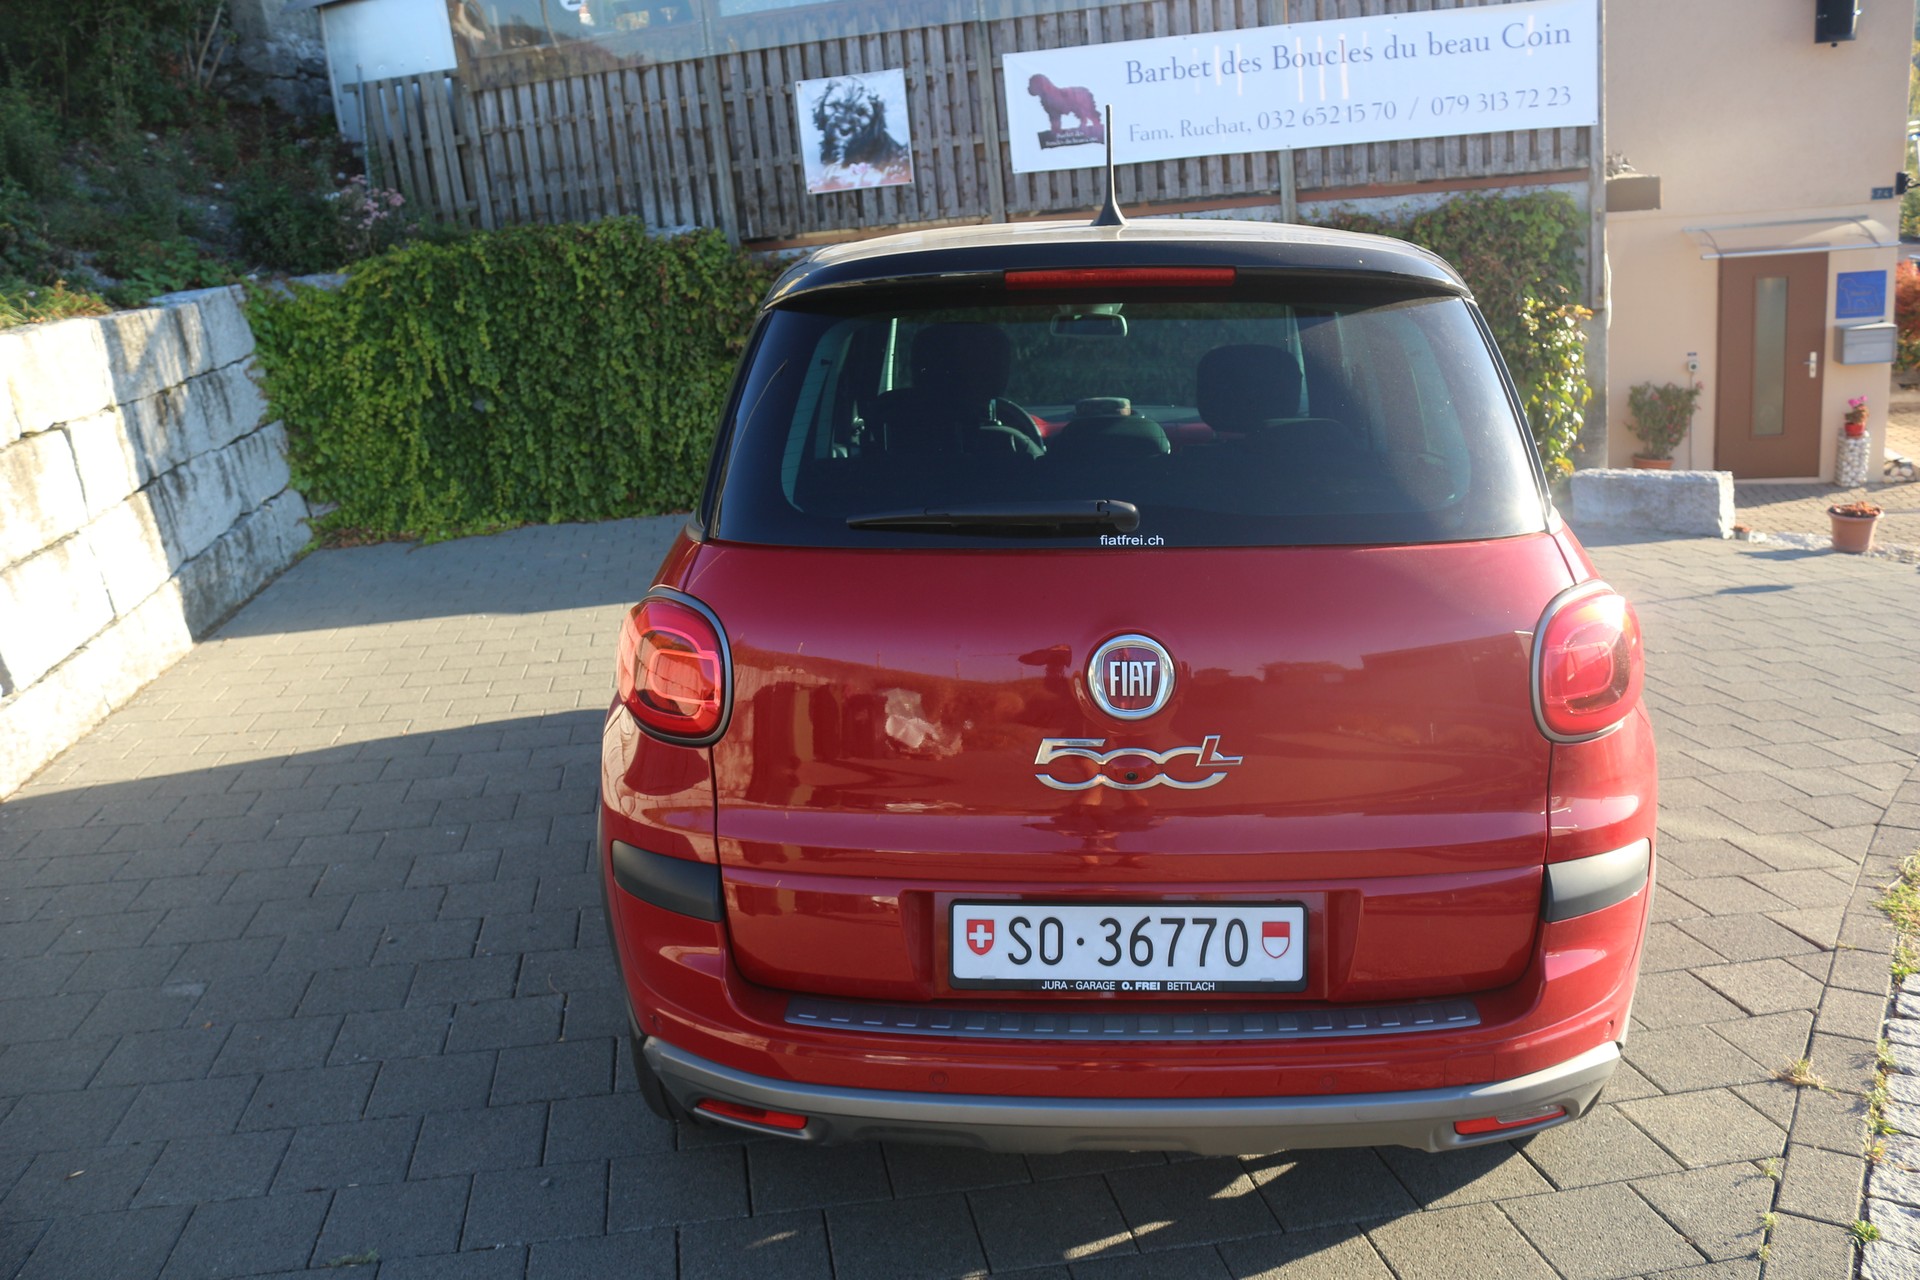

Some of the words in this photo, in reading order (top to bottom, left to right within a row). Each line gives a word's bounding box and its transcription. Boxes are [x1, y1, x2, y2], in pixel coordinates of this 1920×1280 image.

[1125, 57, 1211, 84] Barbet
[1221, 50, 1262, 75] des
[1272, 38, 1373, 70] Boucles
[1384, 34, 1416, 60] du
[1427, 31, 1490, 56] beau
[1502, 22, 1571, 49] Coin
[1128, 123, 1174, 142] Fam.
[1180, 116, 1252, 138] Ruchat,
[1257, 109, 1295, 130] 032
[1302, 105, 1340, 127] 652
[1346, 103, 1366, 123] 15
[1372, 101, 1397, 120] 70
[1431, 94, 1469, 116] 079
[1477, 91, 1508, 112] 313
[1515, 88, 1539, 109] 72
[1547, 86, 1571, 106] 23
[1100, 535, 1164, 546] fiatfrei.ch
[1109, 661, 1156, 696] FIAT
[1041, 981, 1067, 990] JURA
[1075, 981, 1116, 991] GARAGE
[1121, 981, 1133, 990] O.
[1135, 981, 1161, 990] FREI
[1167, 981, 1215, 991] BETTLACH
